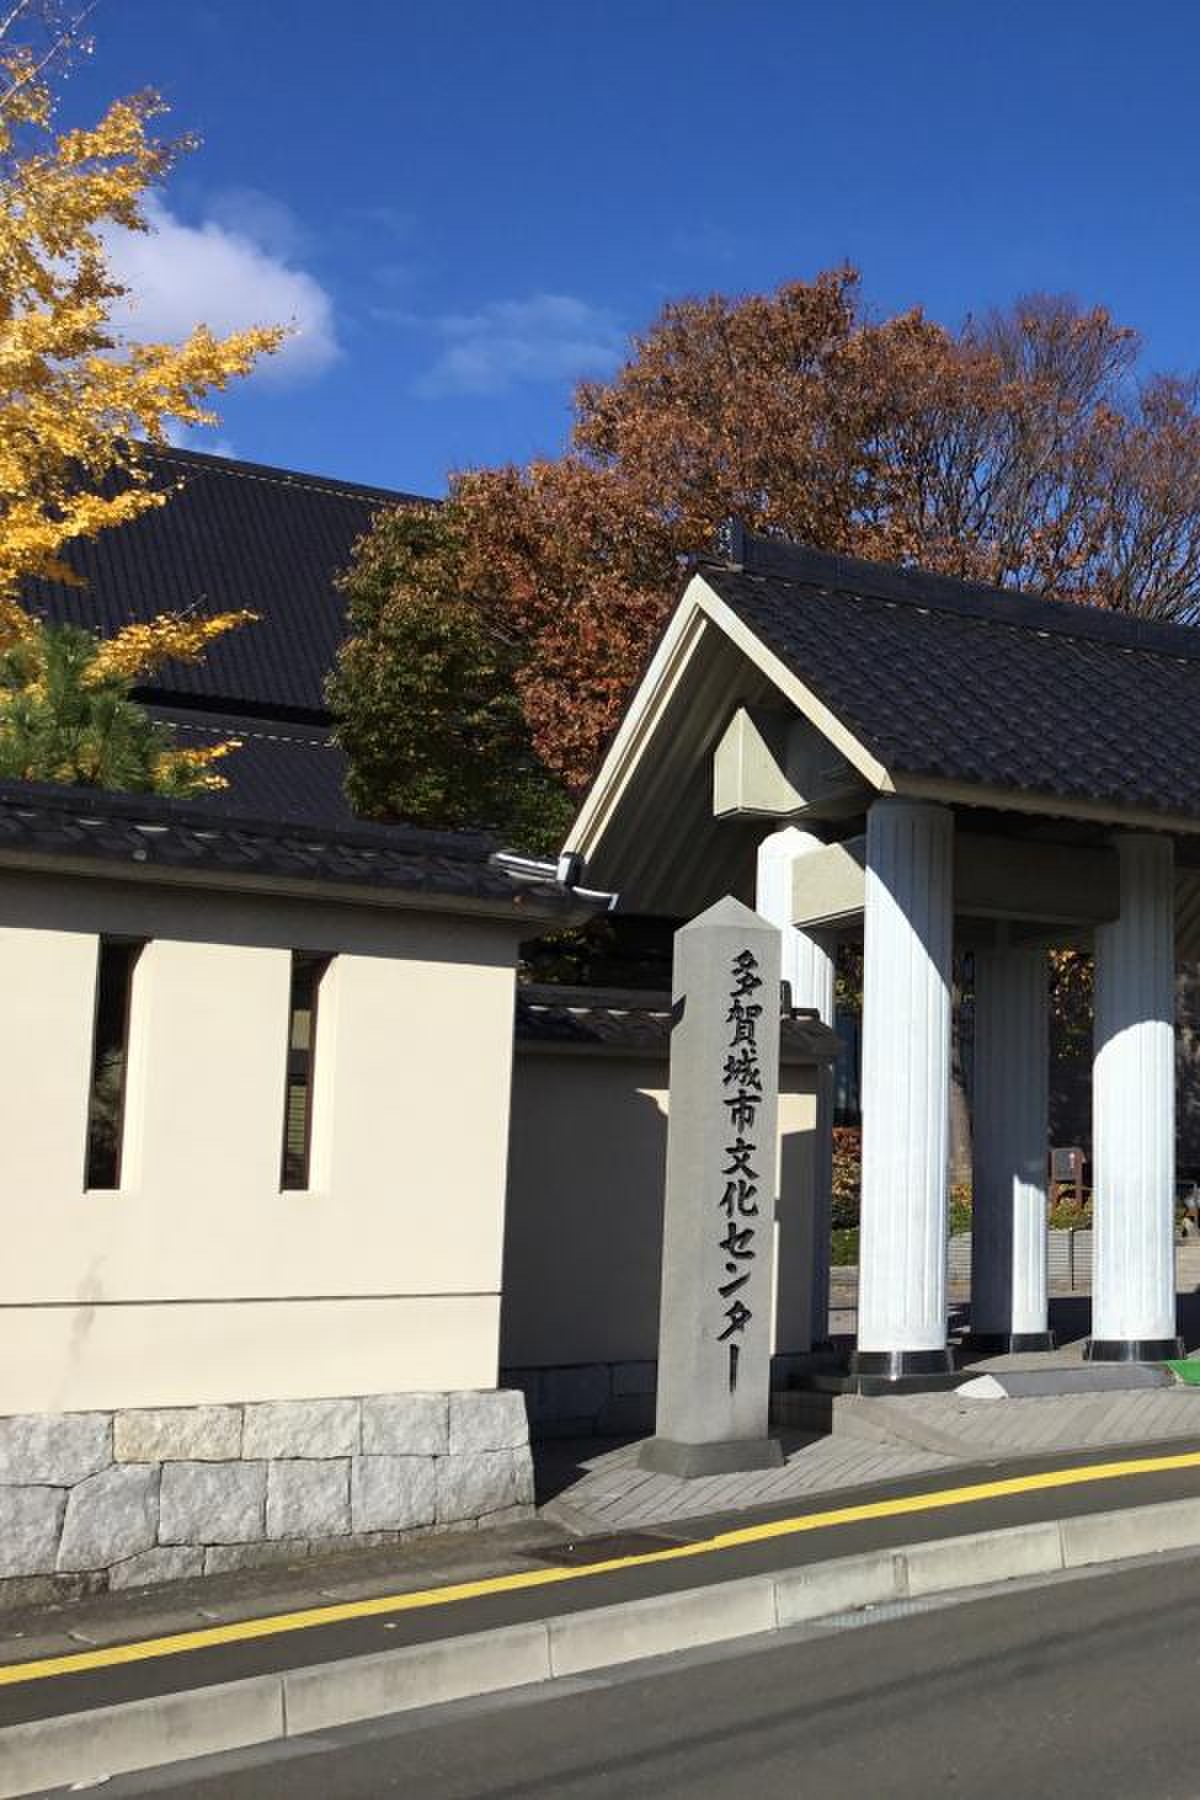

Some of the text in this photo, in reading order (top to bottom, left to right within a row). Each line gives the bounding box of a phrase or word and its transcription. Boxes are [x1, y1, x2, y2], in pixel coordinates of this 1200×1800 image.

[717, 949, 763, 1393] 多賀城市文化センター
